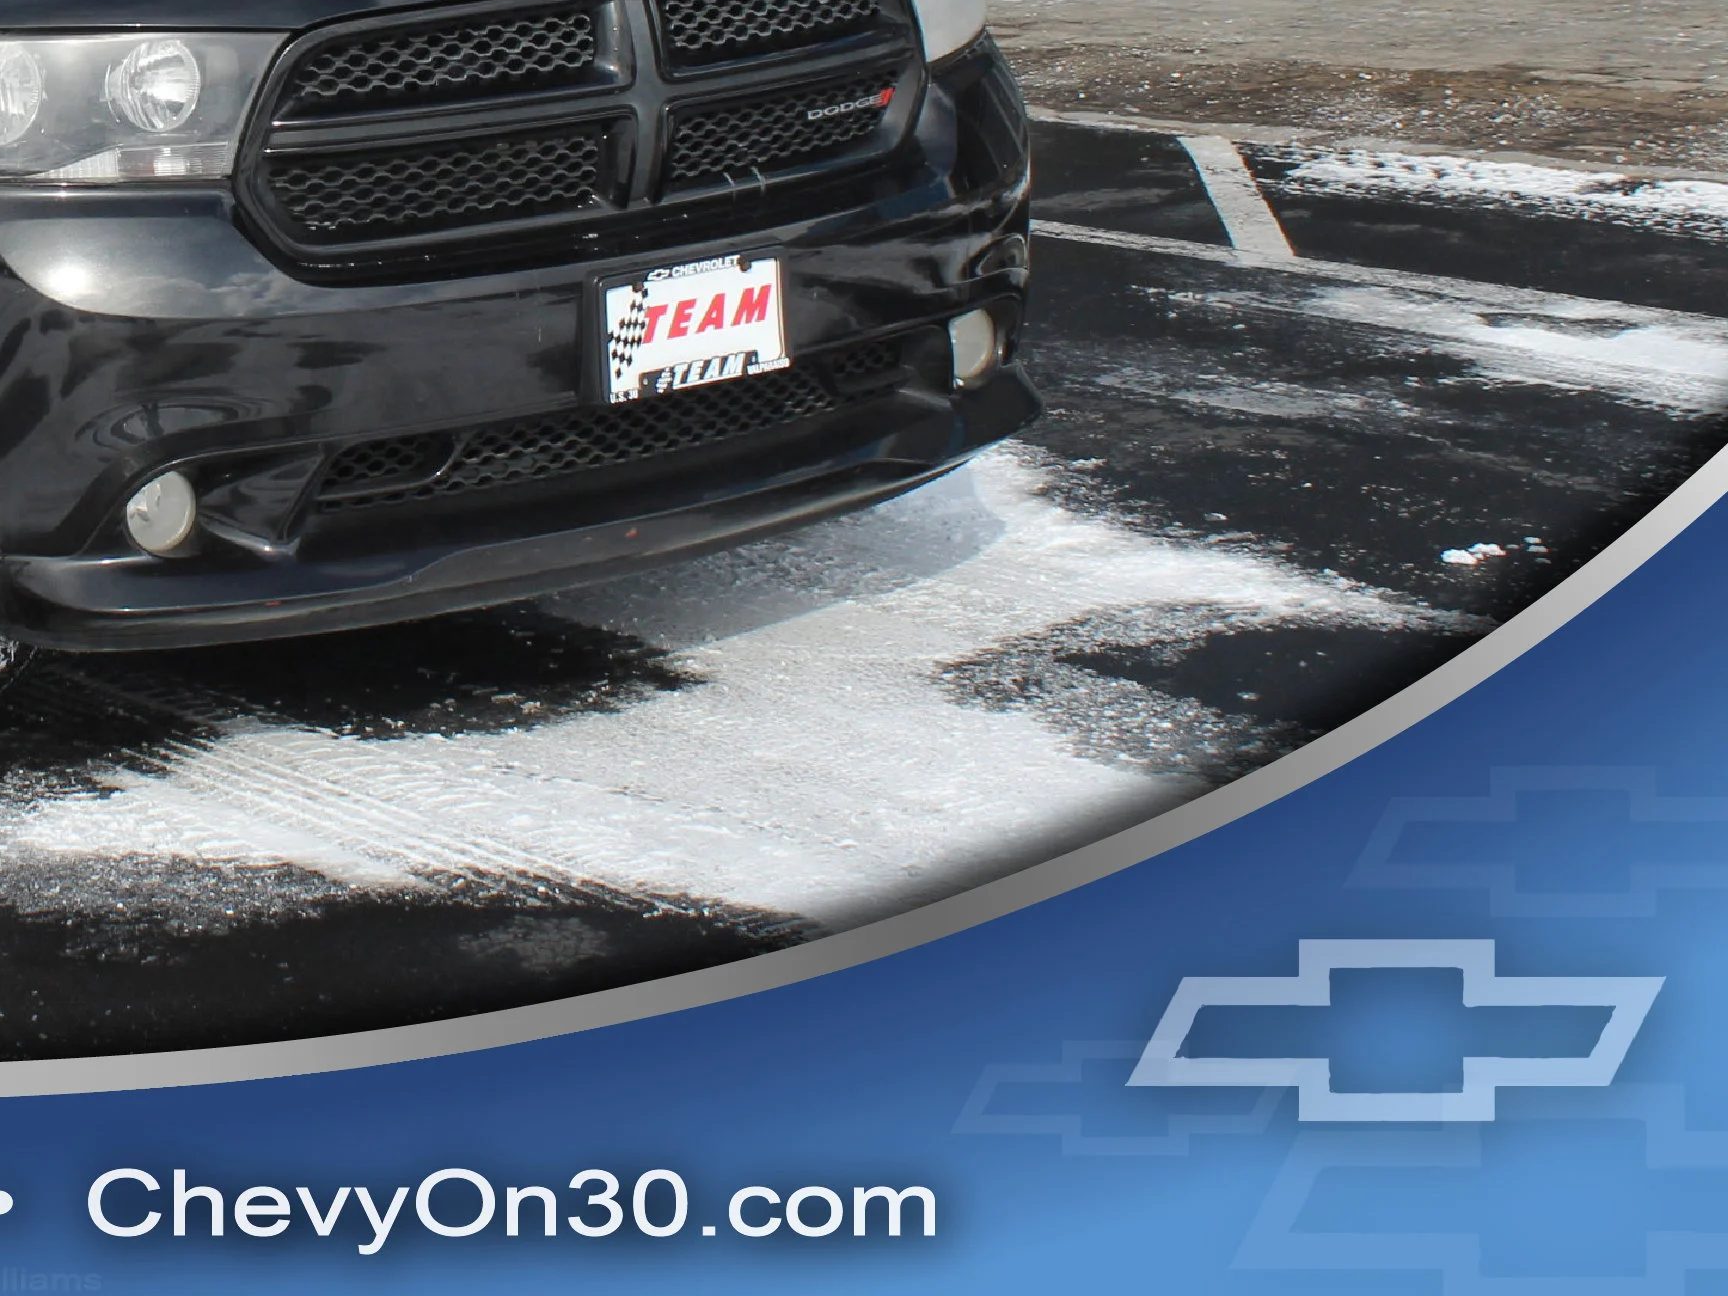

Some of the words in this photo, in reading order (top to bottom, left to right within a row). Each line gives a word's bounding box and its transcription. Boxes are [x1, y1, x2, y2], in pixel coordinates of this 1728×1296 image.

[807, 94, 881, 120] DODGE
[671, 255, 741, 278] CHEVROLET
[642, 283, 772, 344] TEAM
[672, 353, 746, 388] TEAM
